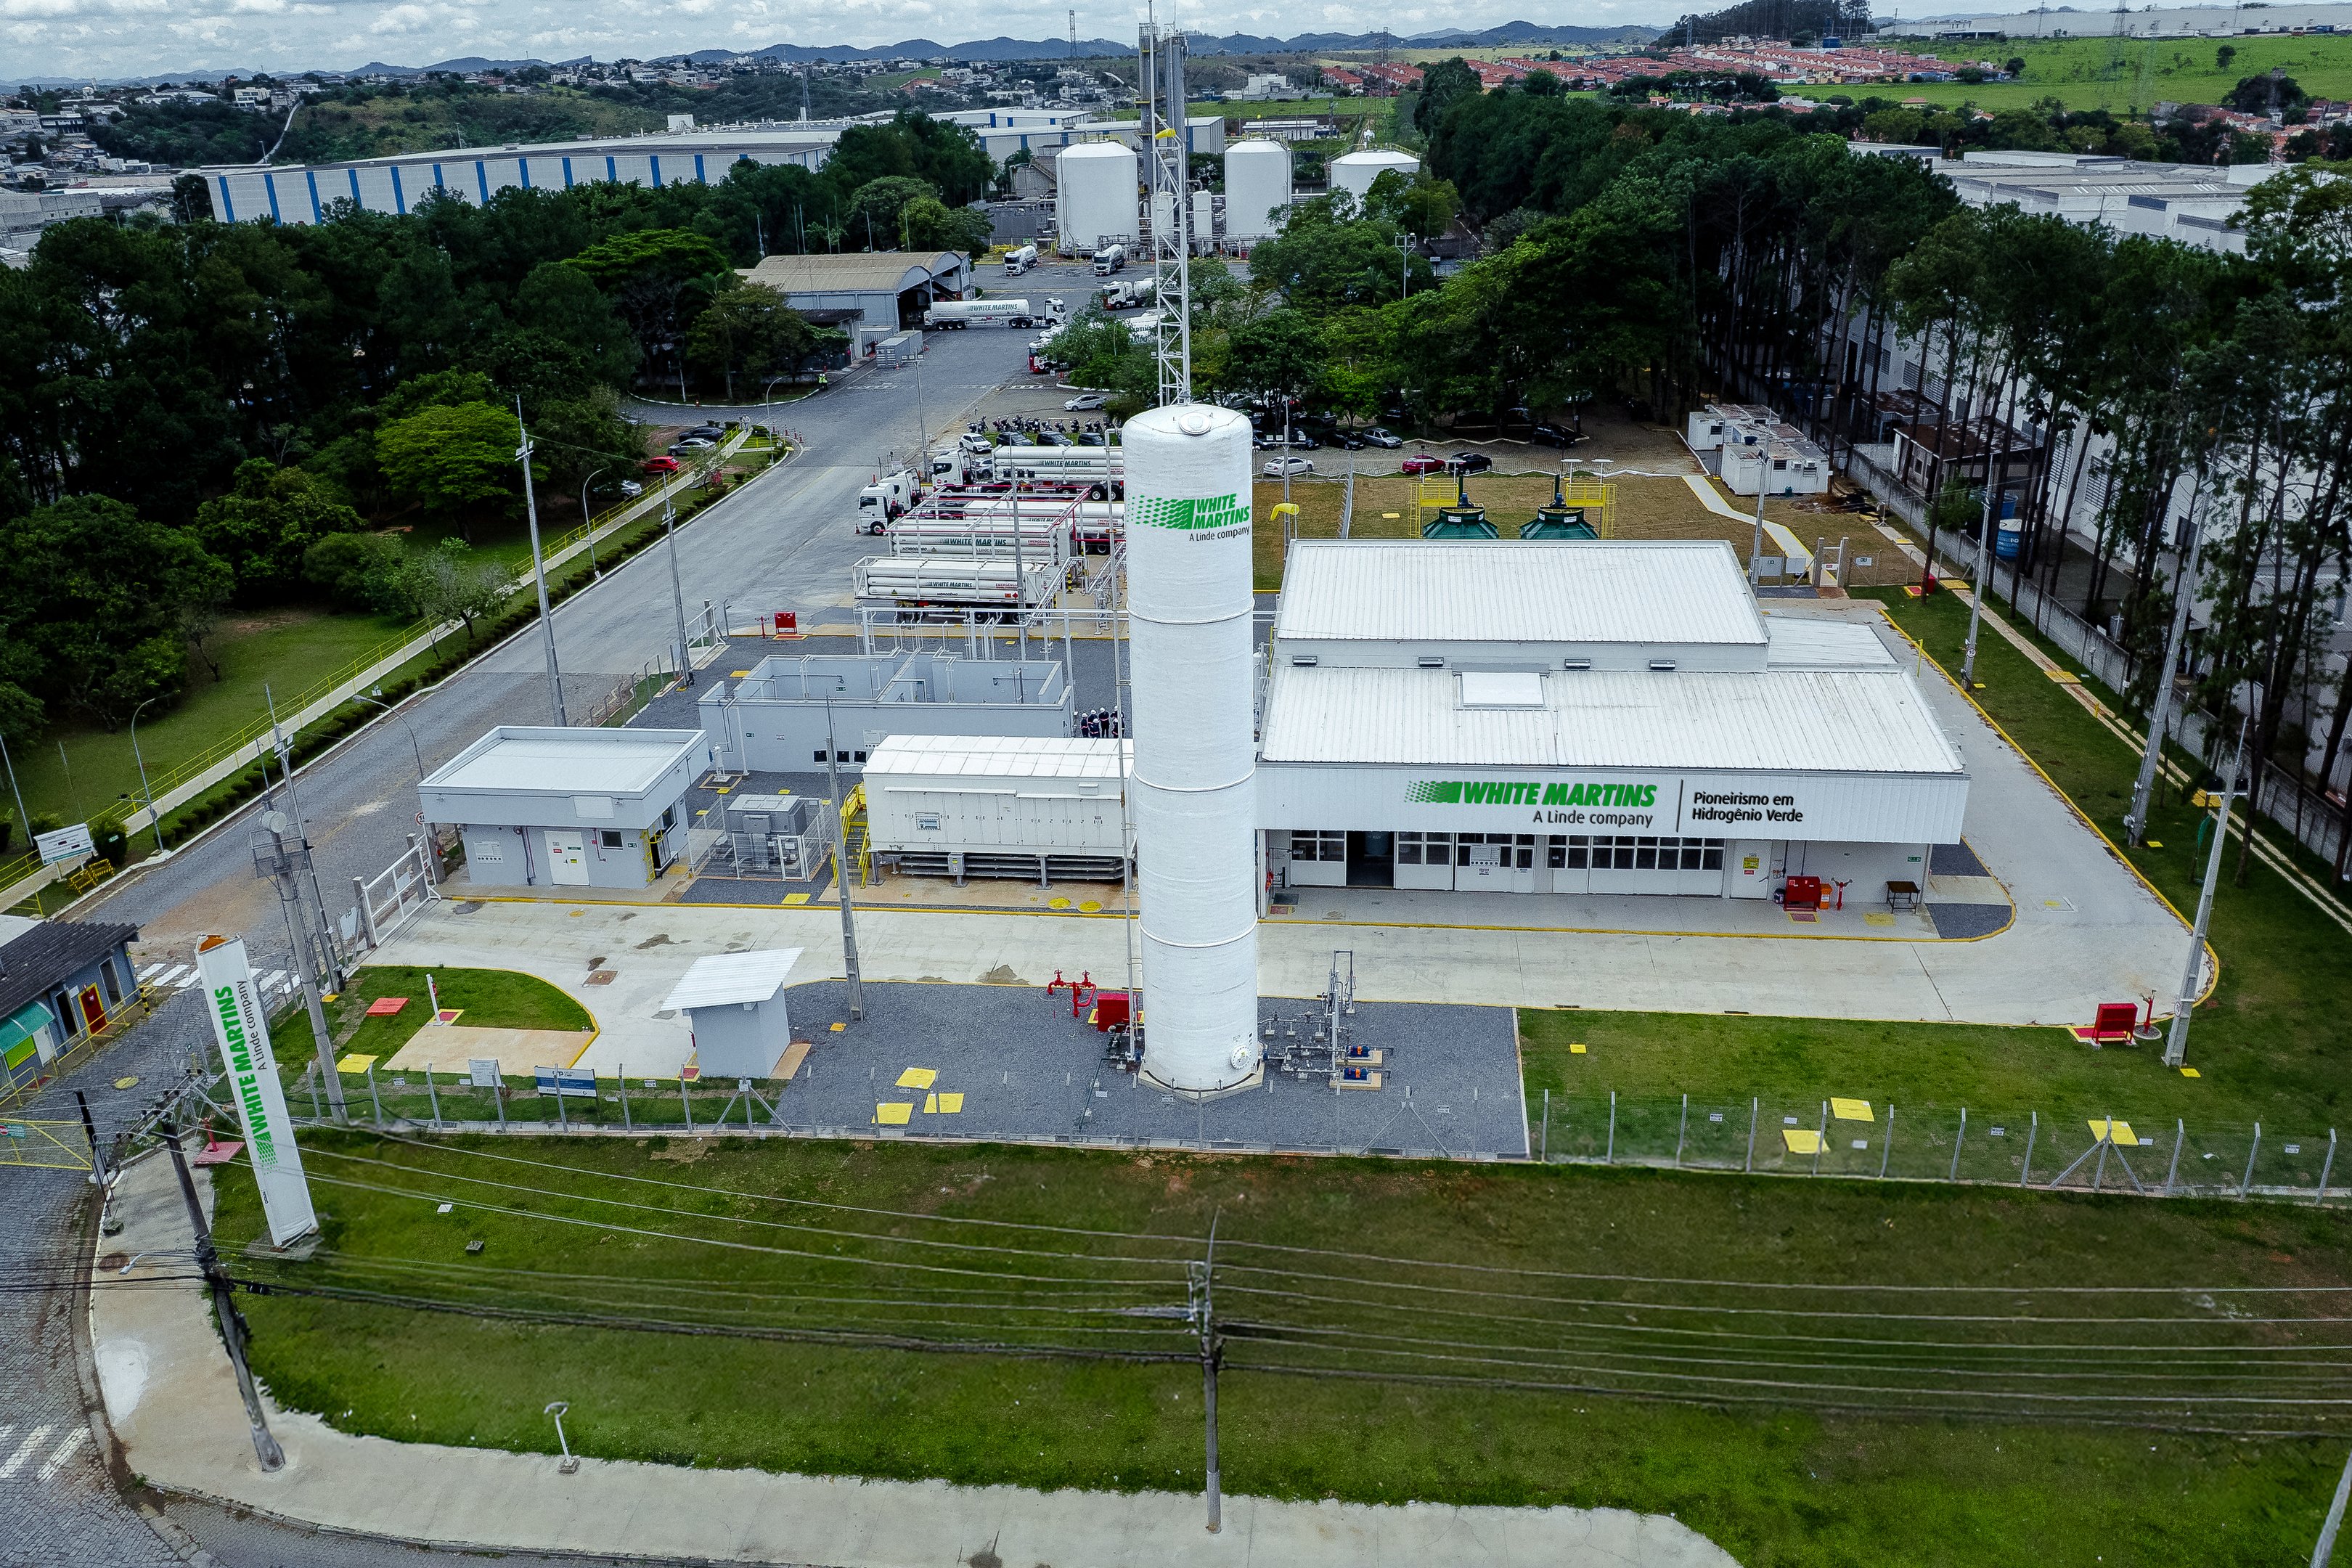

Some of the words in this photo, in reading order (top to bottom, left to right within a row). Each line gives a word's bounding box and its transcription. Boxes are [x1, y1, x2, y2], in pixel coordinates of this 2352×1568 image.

[1197, 493, 1237, 513] WHITE
[1193, 506, 1250, 529] MARTINS
[1196, 532, 1214, 542] Linde
[1217, 526, 1250, 539] company
[1465, 781, 1541, 805] WHITE
[1542, 783, 1657, 807] MARTINS
[1694, 791, 1769, 806] Pioneirismo
[1773, 795, 1794, 806] em
[1532, 810, 1543, 823] A
[1548, 810, 1585, 825] Linde
[1589, 813, 1653, 828] company
[1692, 807, 1763, 824] Hidrogênio
[1766, 808, 1804, 822] Verde
[236, 981, 256, 1029] company
[214, 986, 253, 1072] MARTINS
[250, 1031, 264, 1061] Linde
[257, 1062, 267, 1071] A
[238, 1074, 268, 1136] WHITE
